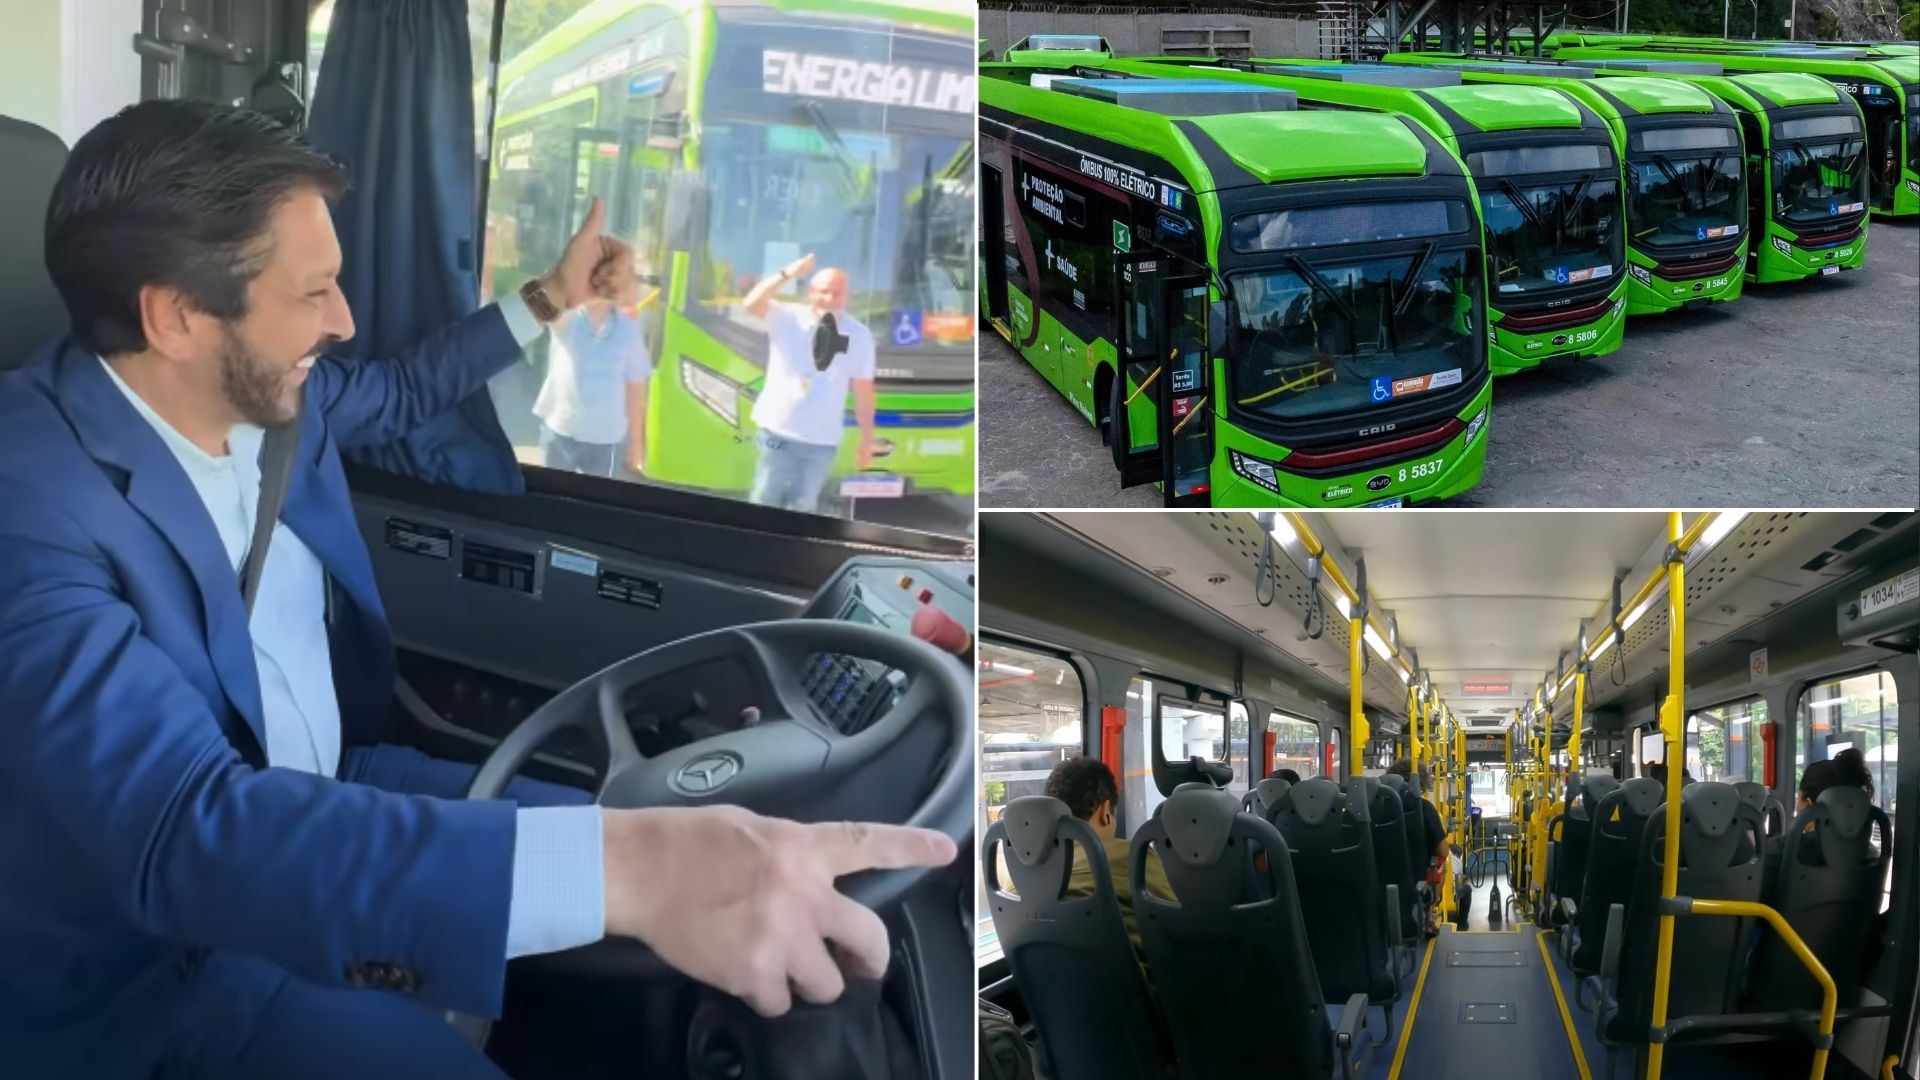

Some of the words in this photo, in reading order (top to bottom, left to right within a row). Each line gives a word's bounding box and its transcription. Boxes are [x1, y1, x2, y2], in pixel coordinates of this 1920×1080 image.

[763, 50, 914, 107] ENERGIA
[1031, 175, 1064, 204] PROTEÇÃO
[1080, 155, 1103, 179] ÔNIBUS
[1104, 166, 1120, 186] 100%
[1120, 171, 1156, 200] ELÉTRICO
[1032, 195, 1064, 225] AMBIENTAL
[1056, 255, 1078, 282] SAÚDE
[1712, 277, 1728, 288] 5845
[1568, 334, 1574, 344] 8
[1576, 329, 1597, 343] 5806
[1359, 423, 1396, 437] CAIO
[1398, 469, 1407, 482] 8
[1411, 458, 1443, 479] 5837
[1327, 487, 1353, 498] ELÉTRICO
[1369, 478, 1390, 489] BYD
[1863, 595, 1868, 610] 7
[1872, 584, 1893, 606] 1034
